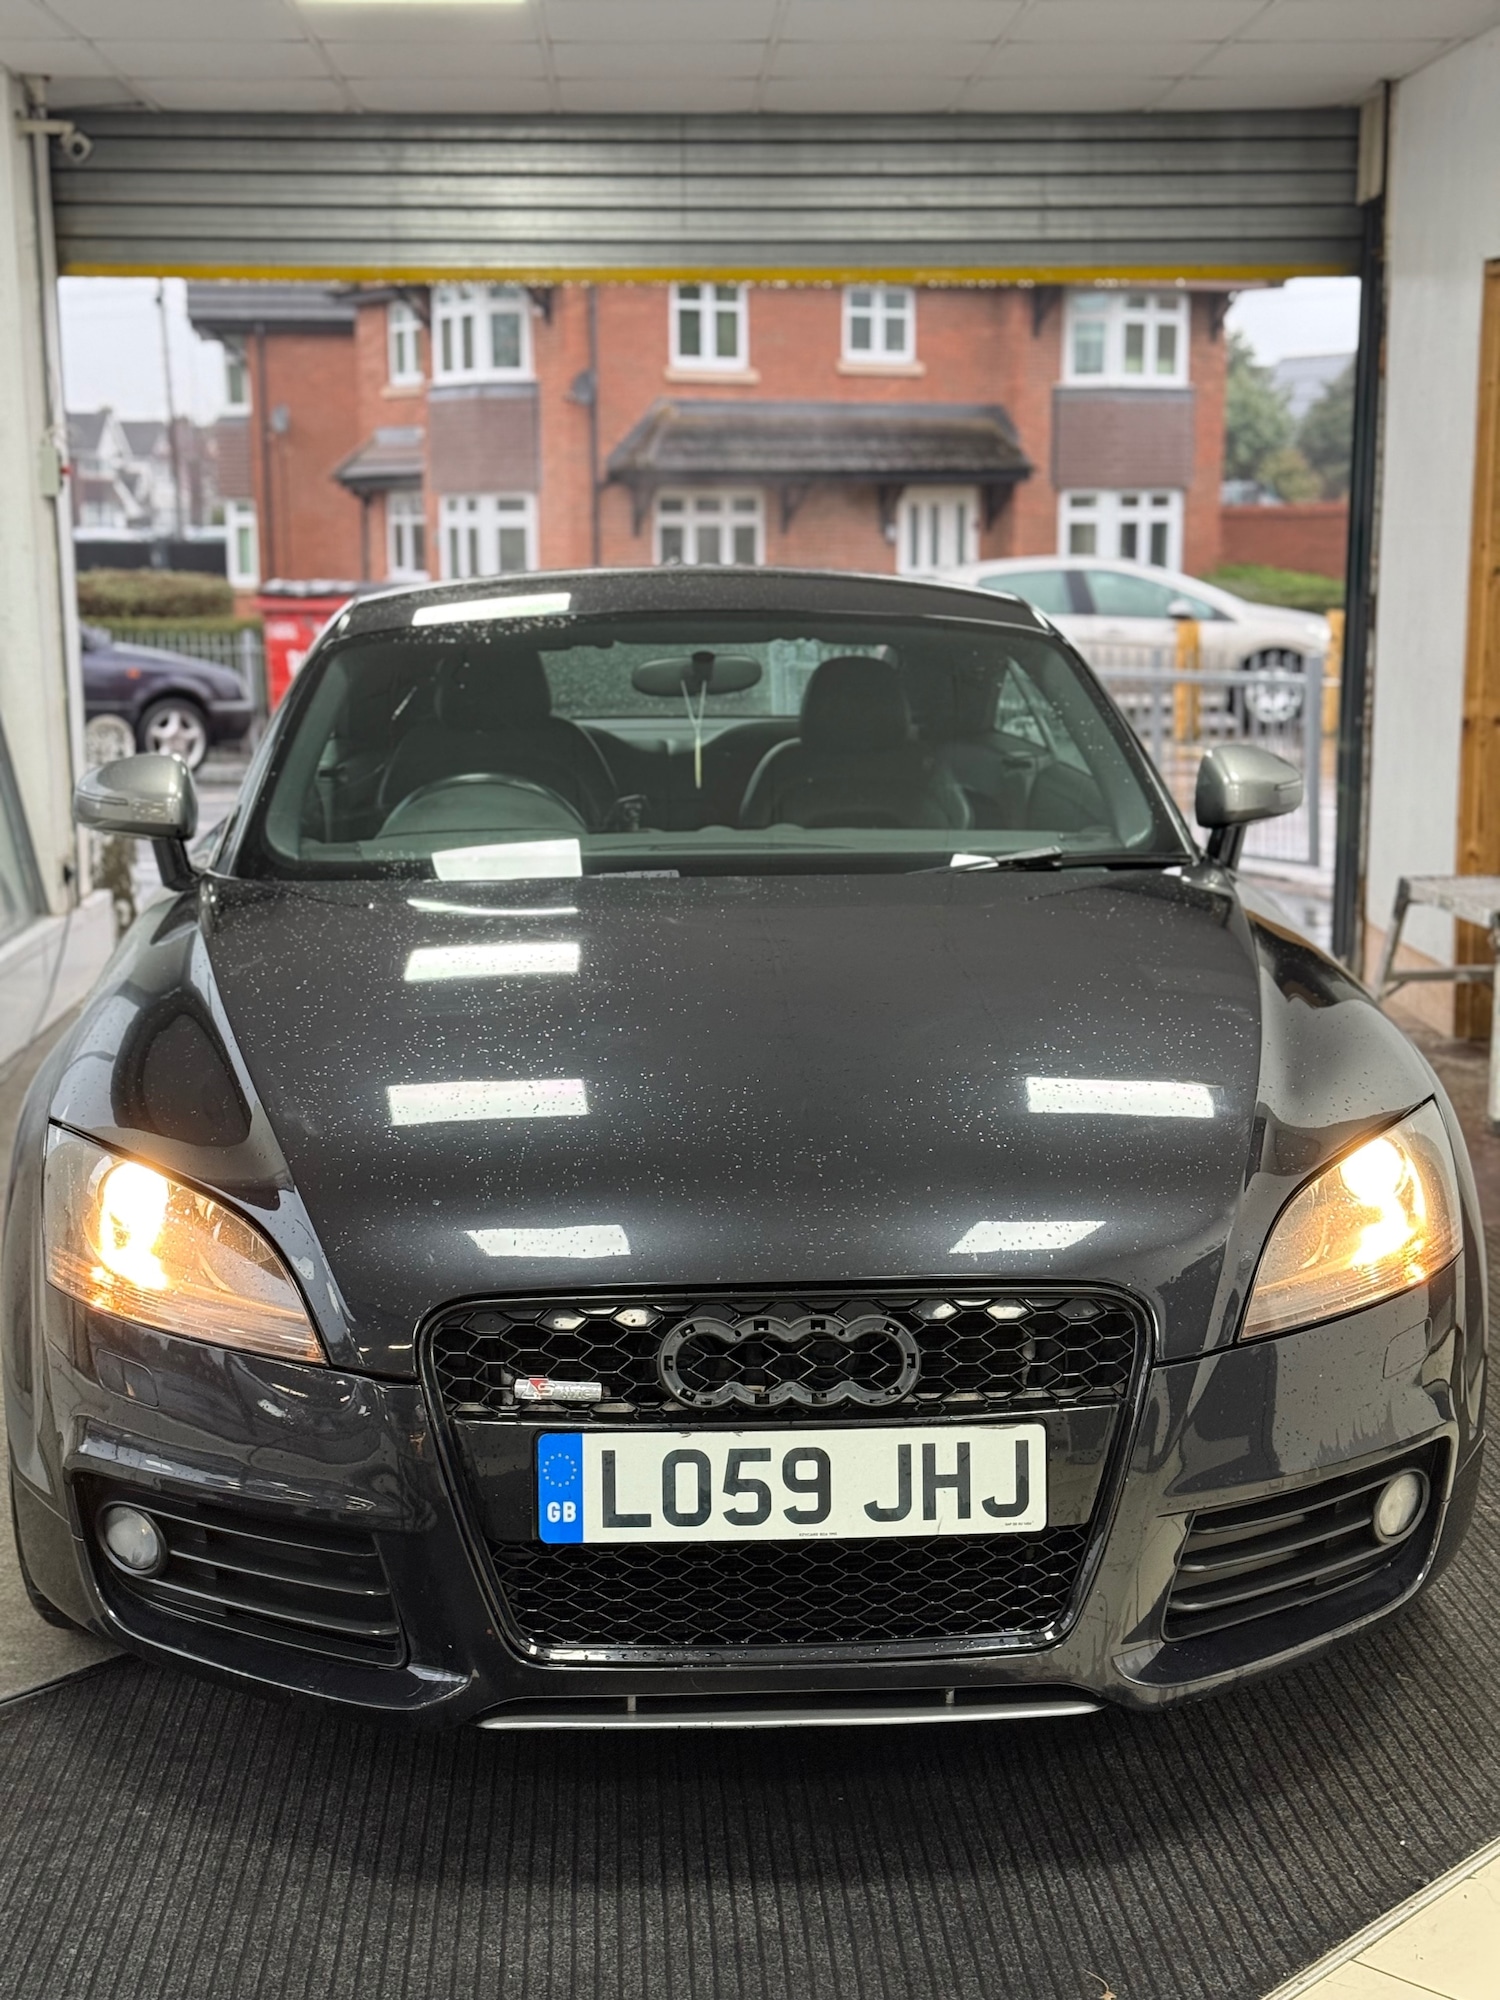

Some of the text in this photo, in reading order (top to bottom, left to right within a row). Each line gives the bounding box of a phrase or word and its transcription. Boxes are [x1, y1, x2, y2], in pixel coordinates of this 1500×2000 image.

[547, 1501, 576, 1523] GB
[601, 1439, 1030, 1529] LO59 JHJ
